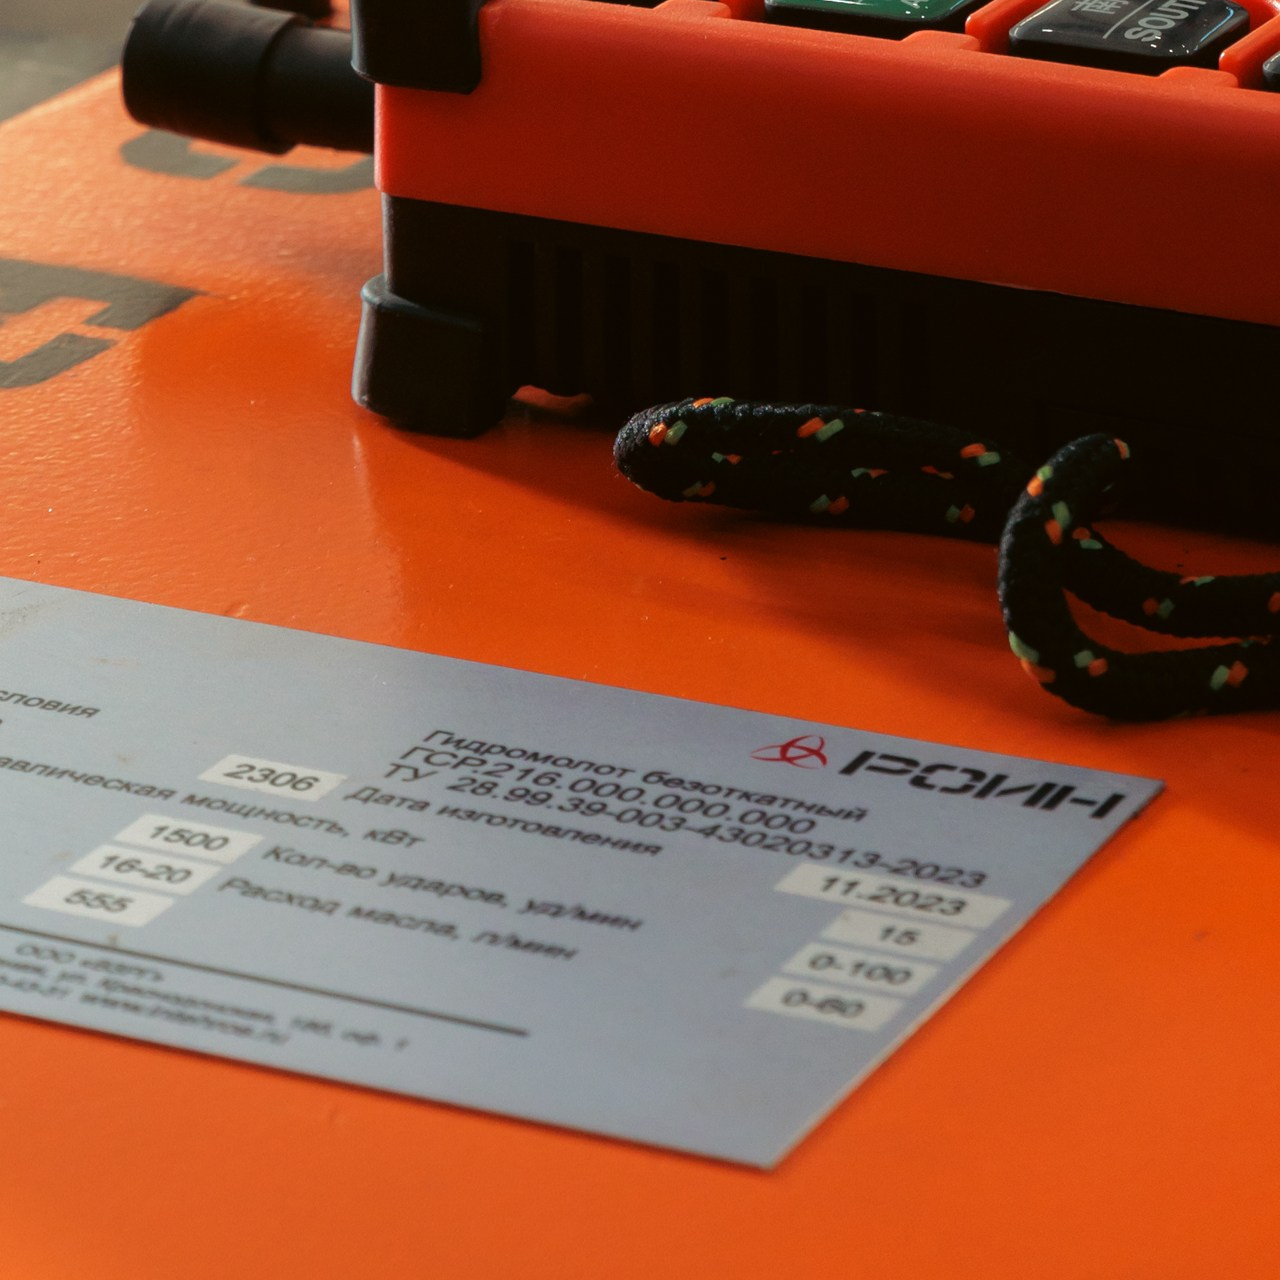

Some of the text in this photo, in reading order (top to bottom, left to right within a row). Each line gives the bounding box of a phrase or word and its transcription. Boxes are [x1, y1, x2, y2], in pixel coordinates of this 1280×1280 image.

[223, 763, 320, 792] 2306
[384, 763, 438, 782] ТУ
[423, 729, 869, 823] Гидромолот безоткатный
[400, 746, 817, 835] ГСР.216.000.000.000
[150, 825, 230, 851] 1500
[180, 793, 350, 838] мощность,
[363, 829, 426, 857] кВт
[342, 786, 663, 857] Дата изготовления
[100, 855, 193, 884] 16-20
[262, 846, 377, 880] Кол-во
[63, 889, 134, 913] 555
[218, 876, 341, 915] Расход
[821, 876, 968, 917] 11.2023
[879, 926, 921, 946] 15
[808, 953, 912, 985] 0-100
